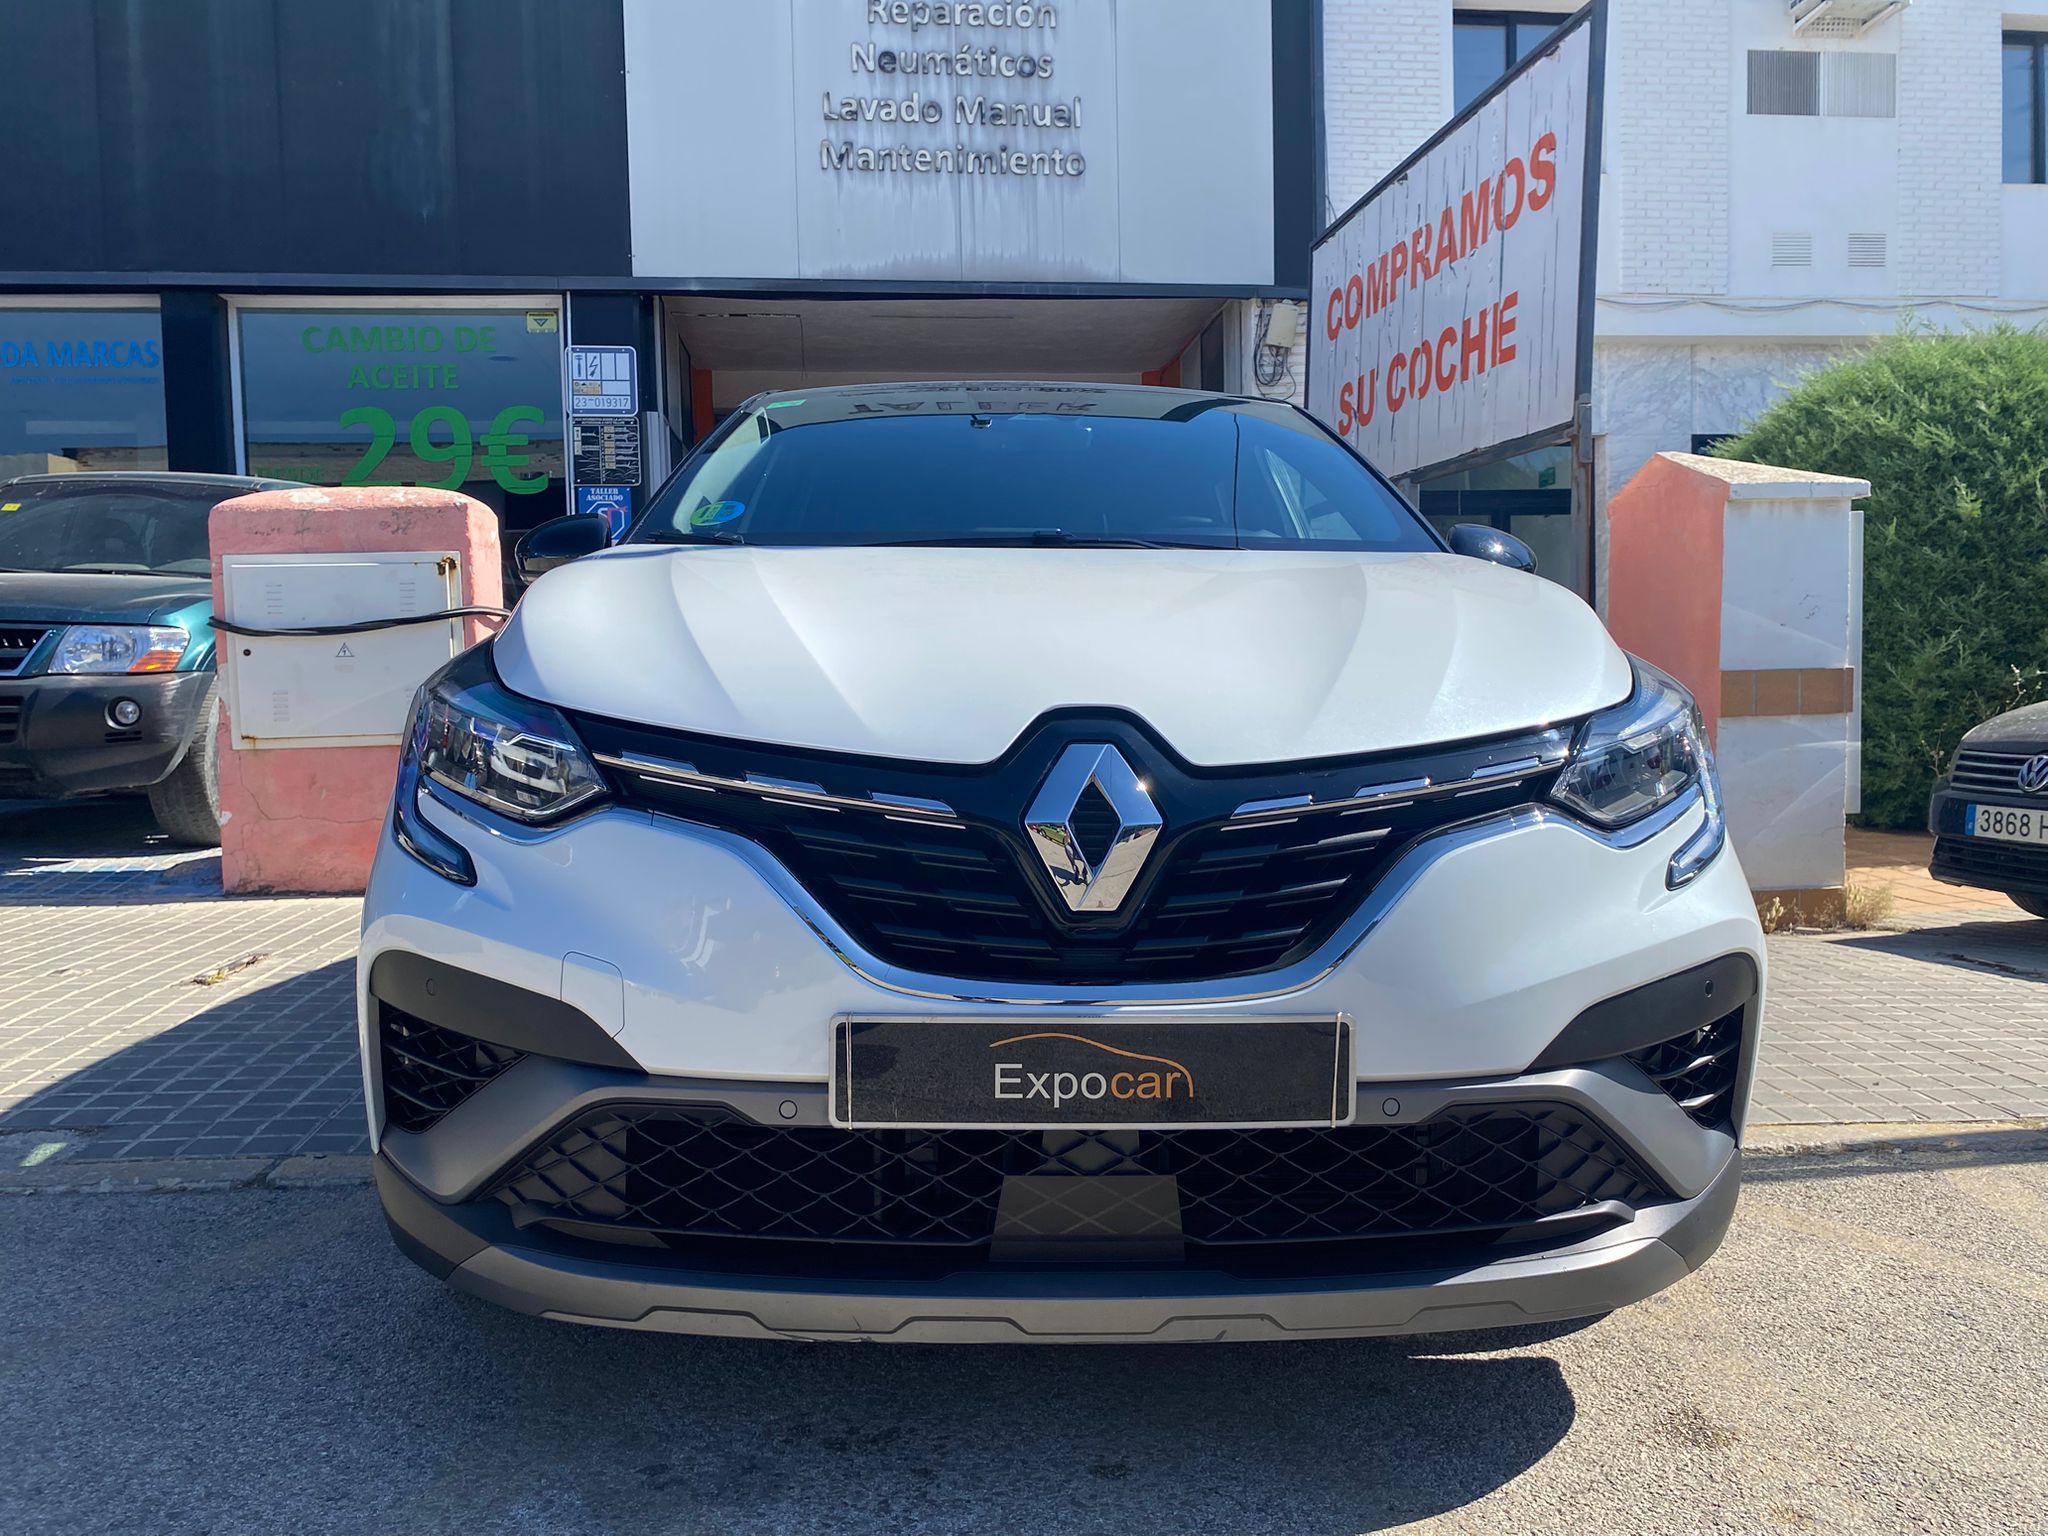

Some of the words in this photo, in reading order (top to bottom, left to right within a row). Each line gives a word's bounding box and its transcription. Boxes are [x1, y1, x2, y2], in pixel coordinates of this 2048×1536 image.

[867, 0, 1058, 32] Reparación
[850, 42, 1054, 79] Neumáticos
[822, 91, 943, 124] Lavado
[954, 95, 1082, 128] Manual
[820, 139, 1086, 177] Mantenimiento
[1327, 131, 1557, 341] COMPRAMOS
[47, 339, 160, 368] MARCAS
[302, 325, 444, 353] CAMBIO
[454, 325, 497, 352] DE
[346, 363, 460, 390] ACEITE
[1338, 368, 1376, 436] SU
[1386, 290, 1519, 413] COCHE
[1980, 809, 2031, 838] 3868
[993, 1062, 1182, 1108] Expocar
